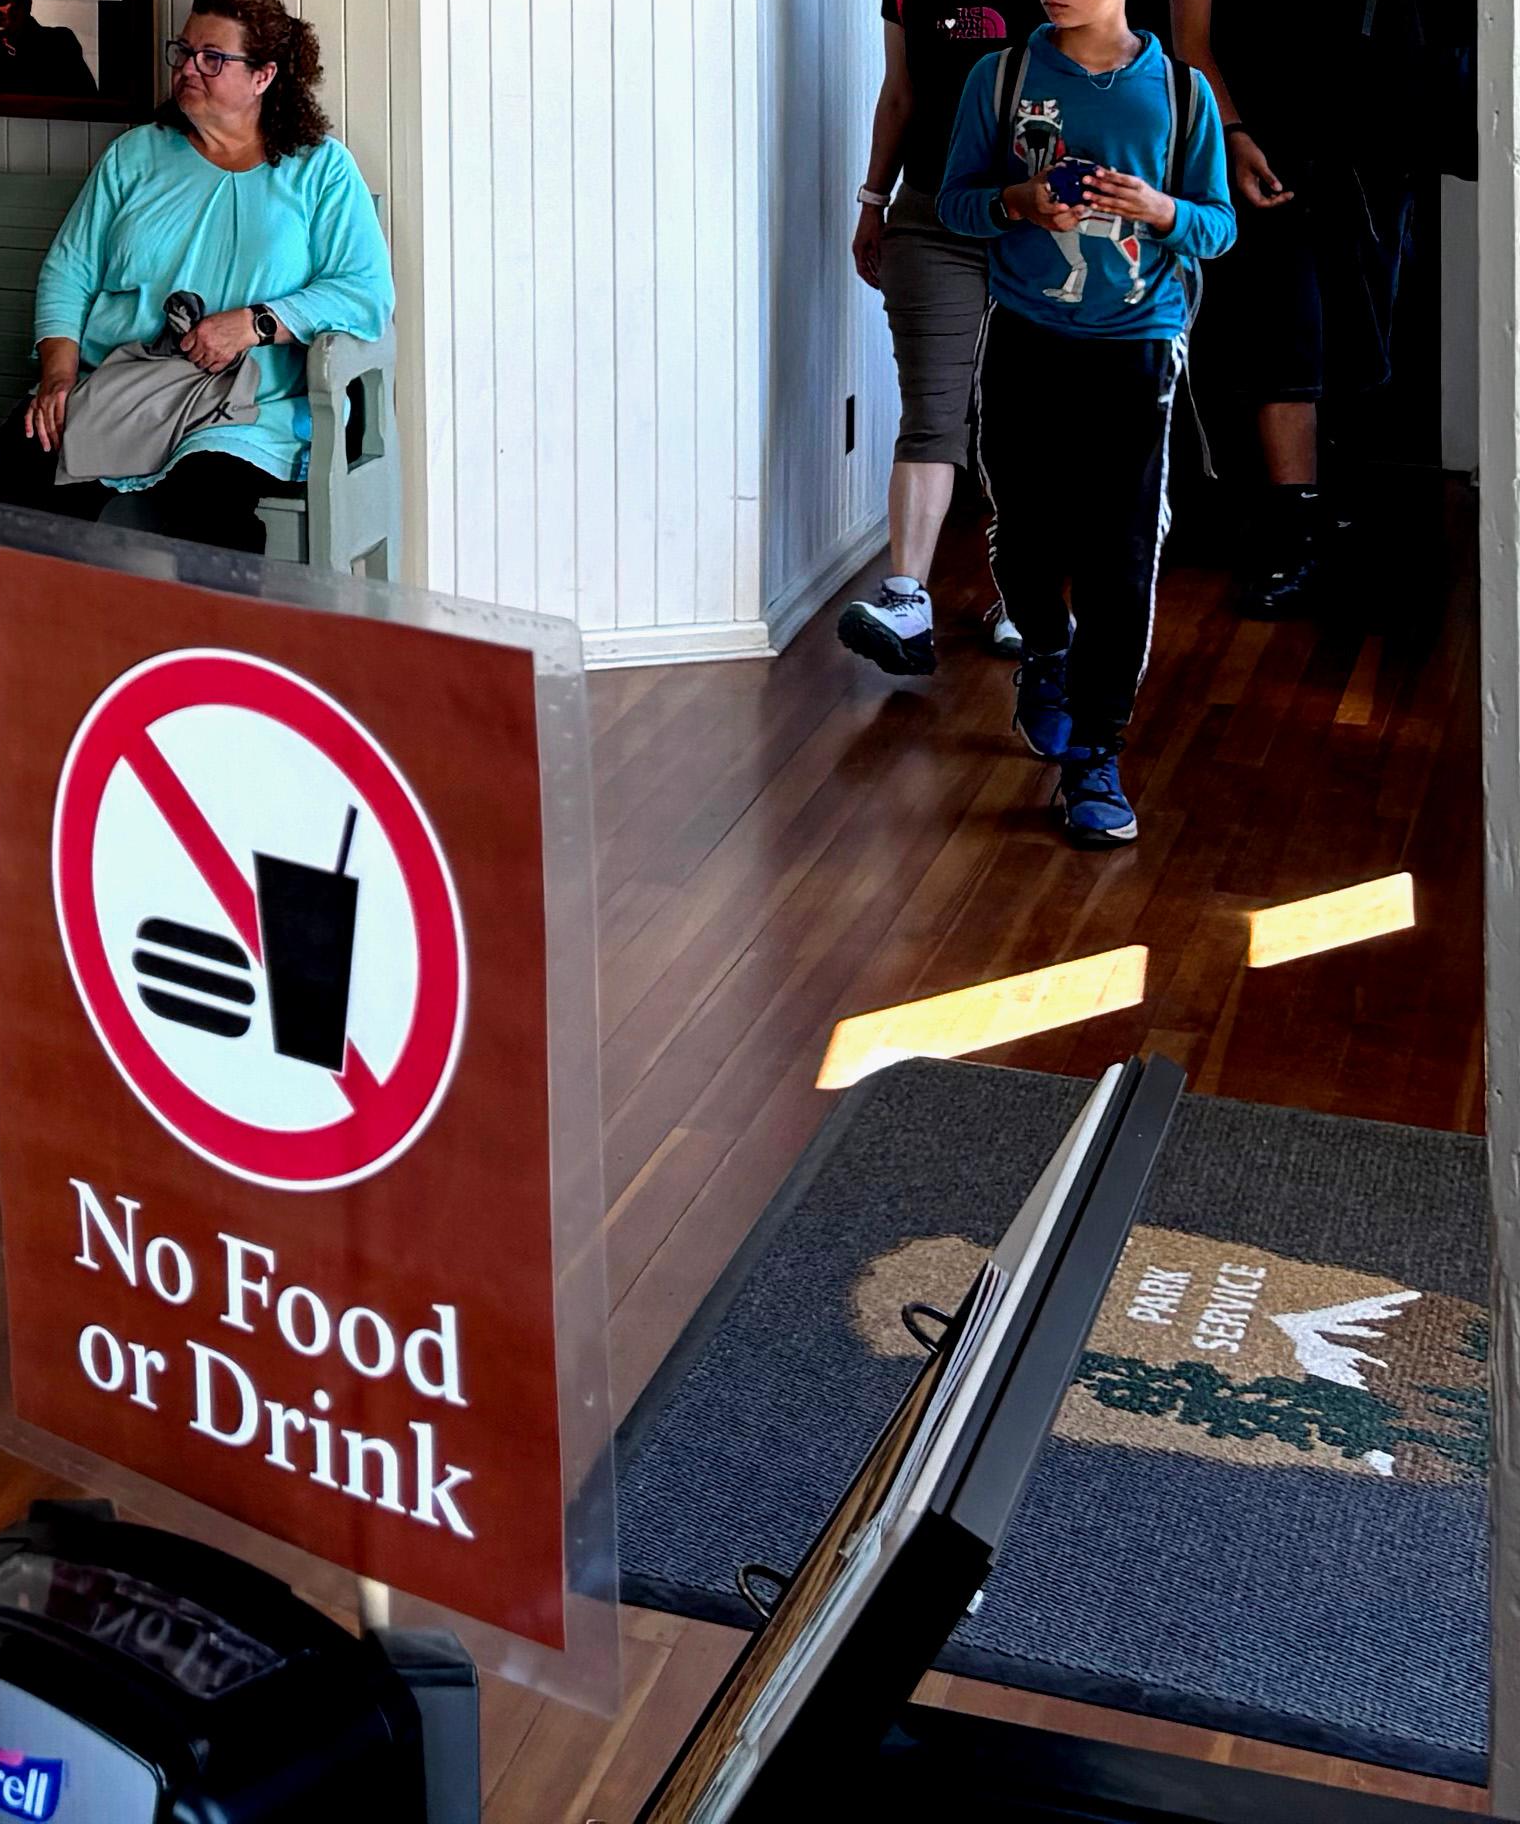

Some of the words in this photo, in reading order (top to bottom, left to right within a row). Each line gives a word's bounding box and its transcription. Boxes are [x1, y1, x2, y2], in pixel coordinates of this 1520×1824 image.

[69, 1177, 195, 1306] No
[218, 1232, 468, 1408] Food
[1125, 1265, 1192, 1325] PARK
[1192, 1262, 1267, 1353] SERVICE
[78, 1324, 166, 1411] or
[186, 1340, 474, 1539] Drink
